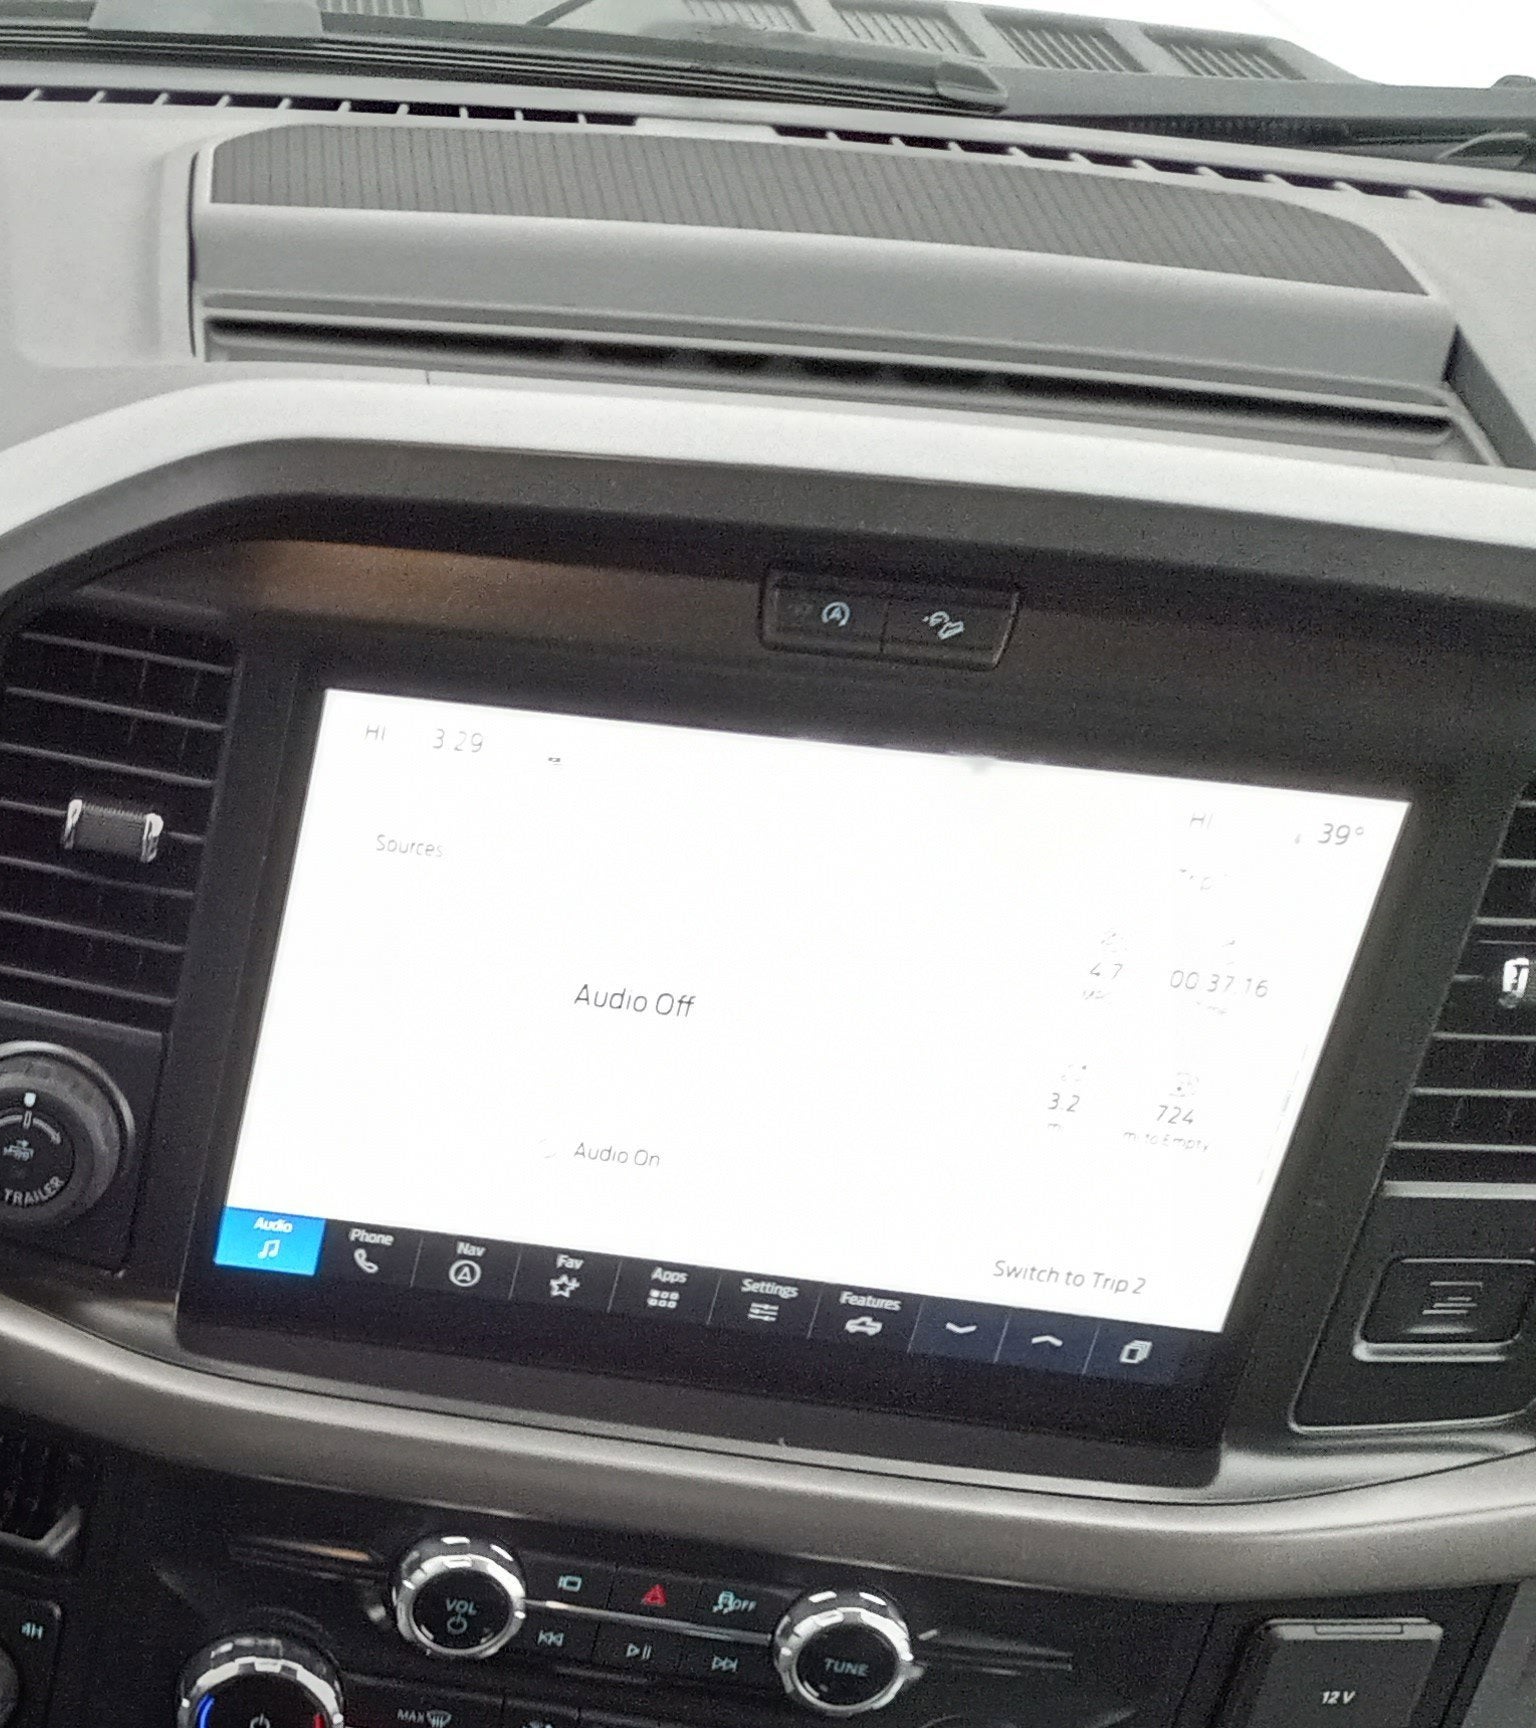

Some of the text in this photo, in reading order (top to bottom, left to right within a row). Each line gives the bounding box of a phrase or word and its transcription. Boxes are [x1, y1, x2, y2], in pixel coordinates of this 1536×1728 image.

[364, 724, 386, 741] HI
[376, 833, 444, 858] Sources
[573, 983, 696, 1018] Audio Off
[1156, 1103, 1195, 1126] 724
[573, 1141, 661, 1168] Audio On
[3, 1174, 66, 1207] TRAILER
[253, 1216, 294, 1234] Audio
[348, 1227, 395, 1247] Phone
[456, 1241, 486, 1258] Nav
[555, 1253, 584, 1271] Fav
[650, 1266, 688, 1285] Apps
[992, 1259, 1147, 1295] Switch to Trip 2
[740, 1277, 799, 1300] Settings
[839, 1290, 902, 1312] Features
[445, 1598, 478, 1616] VOL
[732, 1598, 757, 1613] OFF
[824, 1657, 871, 1678] TUNE
[396, 1708, 426, 1724] MAX
